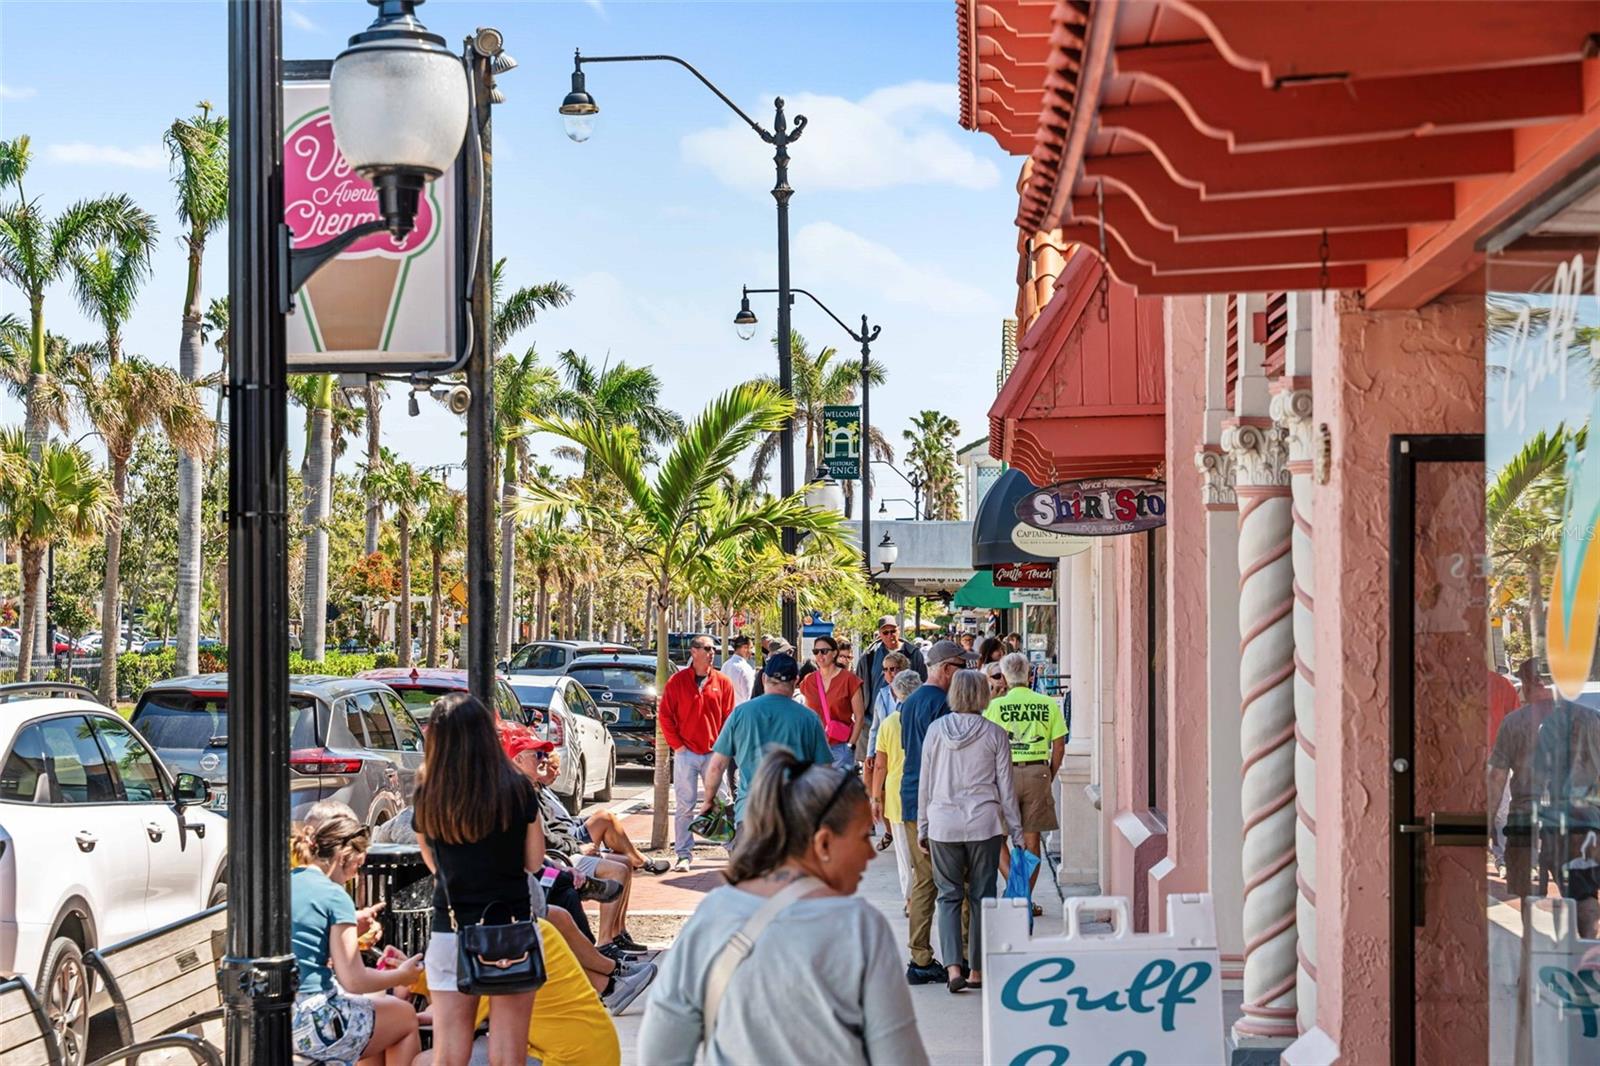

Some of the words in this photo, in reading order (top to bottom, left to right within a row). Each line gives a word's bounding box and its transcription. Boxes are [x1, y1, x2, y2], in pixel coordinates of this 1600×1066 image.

[312, 179, 379, 207] Avenu
[1115, 488, 1166, 522] Sto
[1025, 568, 1052, 580] Touch
[1000, 703, 1021, 712] NEW
[1024, 703, 1049, 711] YORK
[1000, 711, 1049, 722] CRANE
[1001, 957, 1212, 1032] Gulf
